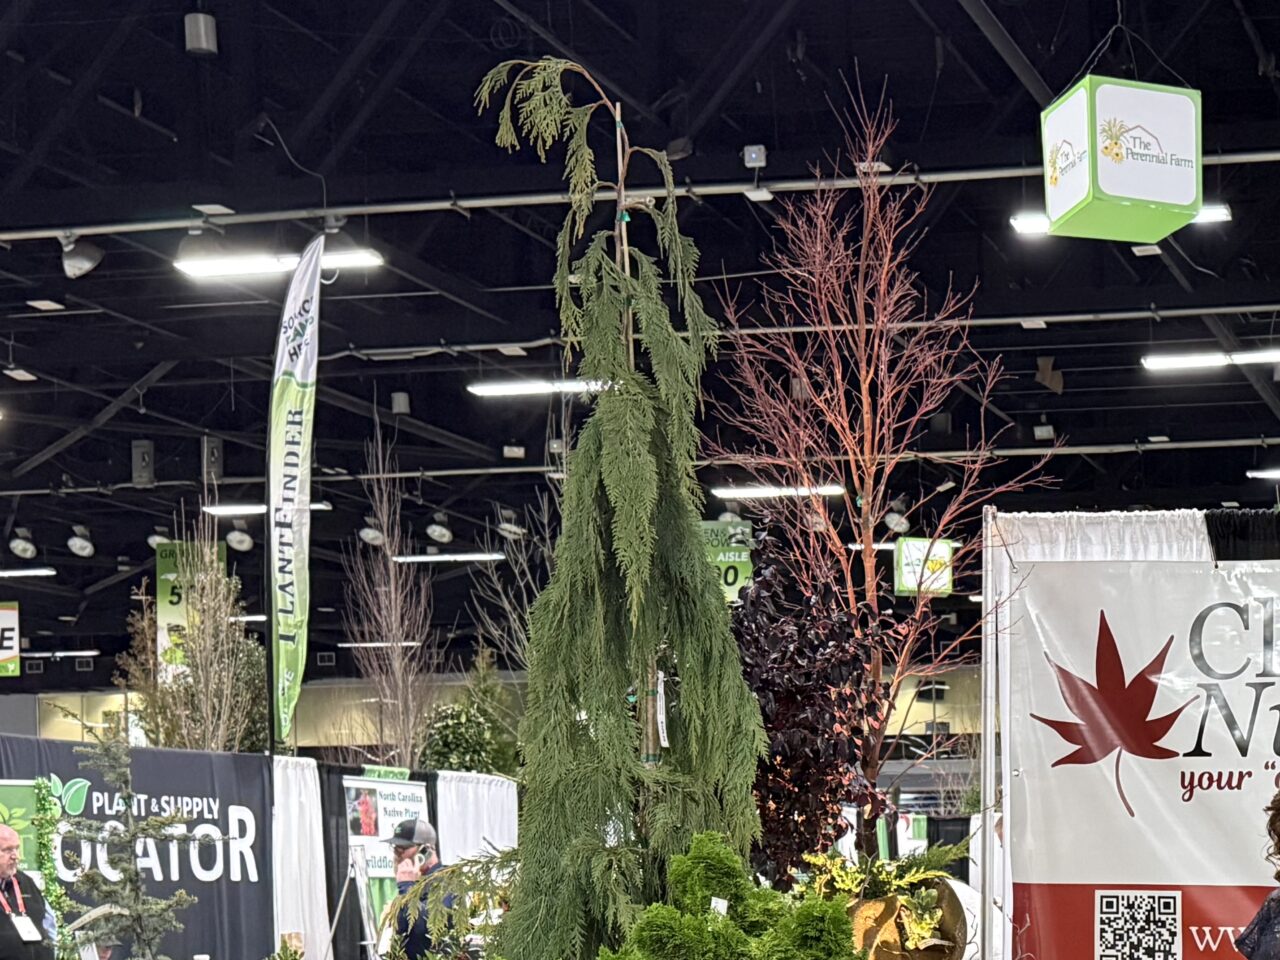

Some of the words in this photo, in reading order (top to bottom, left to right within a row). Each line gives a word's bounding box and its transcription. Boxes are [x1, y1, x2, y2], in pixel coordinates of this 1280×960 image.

[1130, 136, 1151, 151] The
[1126, 148, 1168, 165] Perennial
[1170, 154, 1194, 169] Farm
[717, 552, 749, 562] AISLE
[1180, 770, 1253, 802] your
[92, 791, 148, 817] PLANT
[150, 798, 160, 813] &
[160, 795, 221, 820] SUPPLY
[379, 790, 396, 801] North
[397, 791, 423, 803] Carolina
[383, 806, 403, 818] Native
[53, 804, 259, 883] OCATOR
